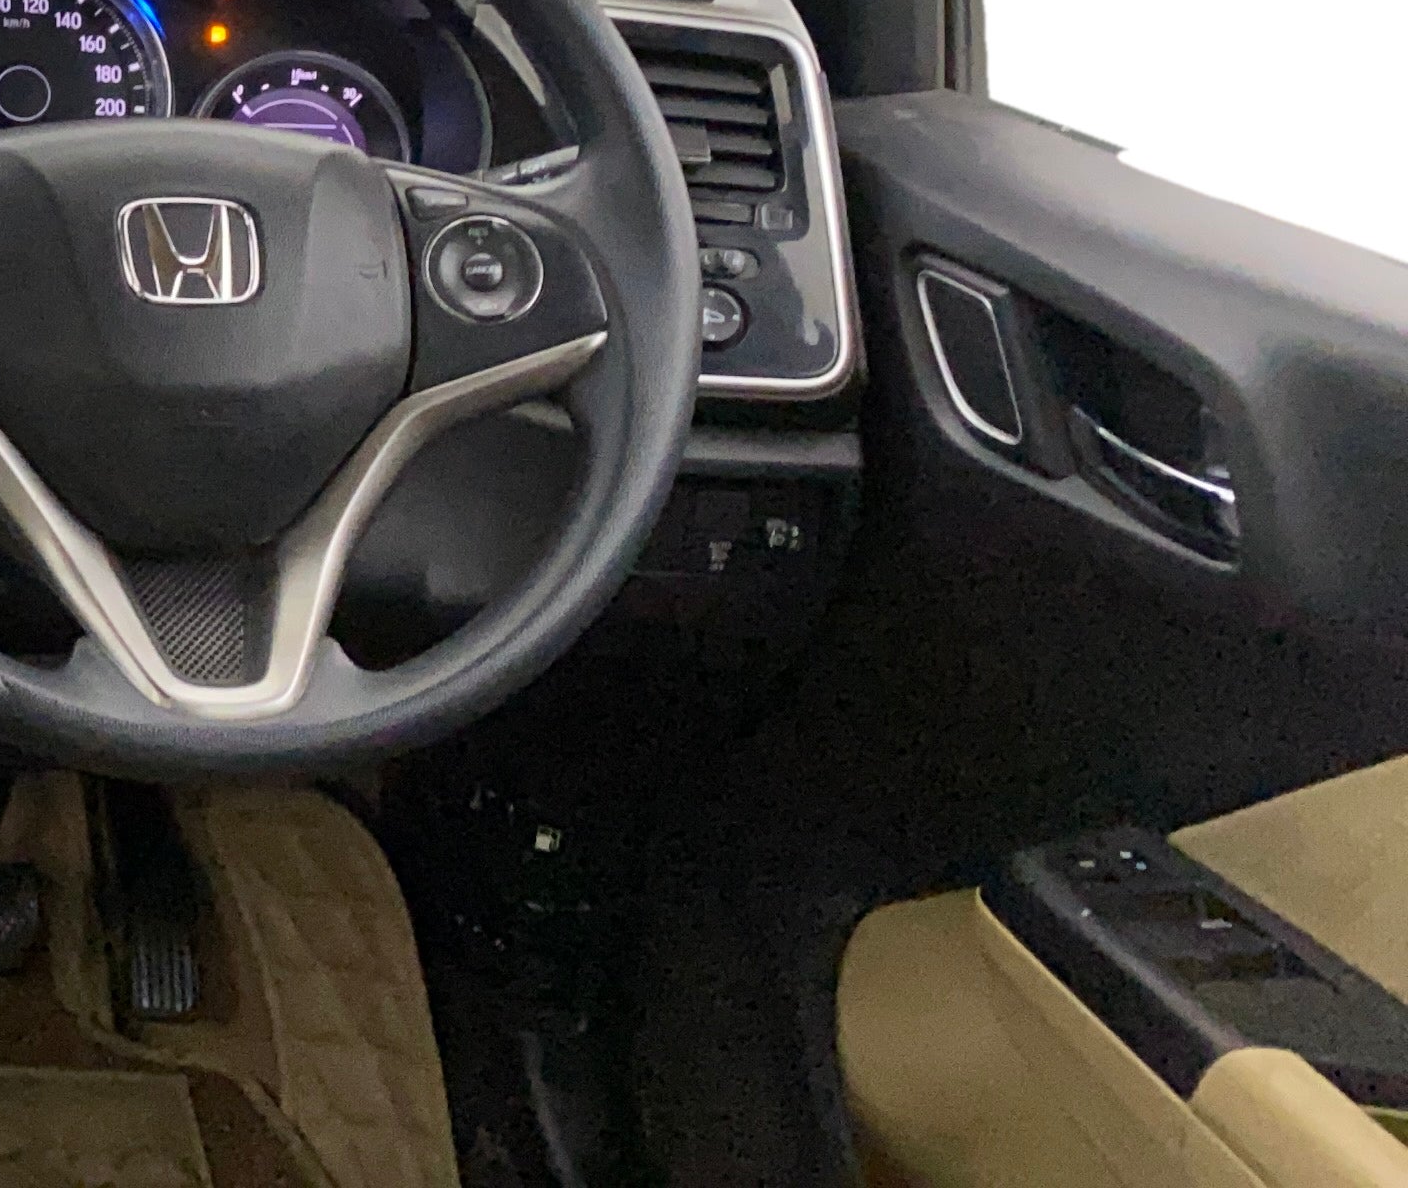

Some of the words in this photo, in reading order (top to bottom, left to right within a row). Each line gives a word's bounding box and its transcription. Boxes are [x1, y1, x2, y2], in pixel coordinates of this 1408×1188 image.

[54, 11, 82, 30] 140
[79, 35, 107, 54] 160
[95, 65, 122, 84] 180
[95, 98, 127, 117] 200
